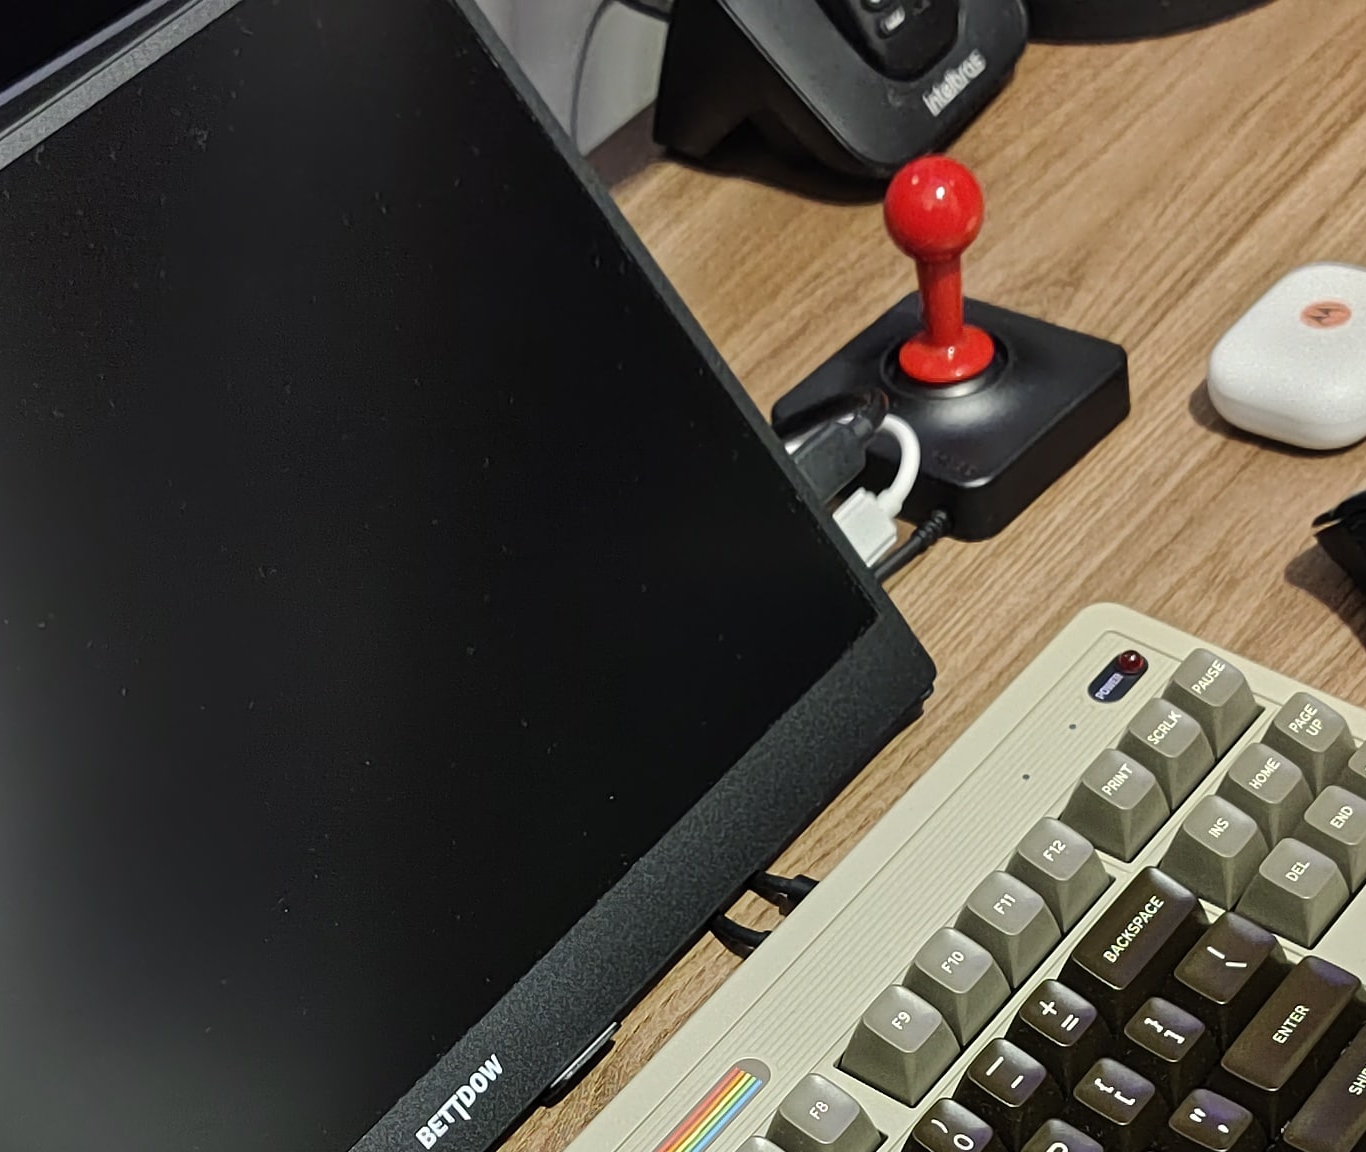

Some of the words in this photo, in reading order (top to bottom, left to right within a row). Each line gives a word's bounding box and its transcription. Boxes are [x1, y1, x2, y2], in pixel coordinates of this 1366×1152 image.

[922, 48, 987, 117] intelbras
[1192, 660, 1225, 694] PAUSE
[1146, 709, 1183, 745] SCRLK
[1288, 703, 1319, 735] PAGE
[1304, 719, 1323, 737] UP
[1101, 764, 1136, 797] PRINT
[1249, 758, 1280, 789] HOME
[1209, 818, 1228, 837] INS
[1330, 806, 1352, 828] END
[1043, 840, 1065, 861] F12
[1286, 862, 1309, 881] DEL
[994, 894, 1015, 914] F11
[1103, 896, 1164, 962] BACKSPACE
[942, 952, 964, 973] F10
[892, 1012, 910, 1029] F9
[1273, 1006, 1309, 1043] ENTER
[416, 1054, 502, 1149] BETTDOW
[810, 1102, 828, 1119] F8
[954, 1134, 974, 1150] 0
